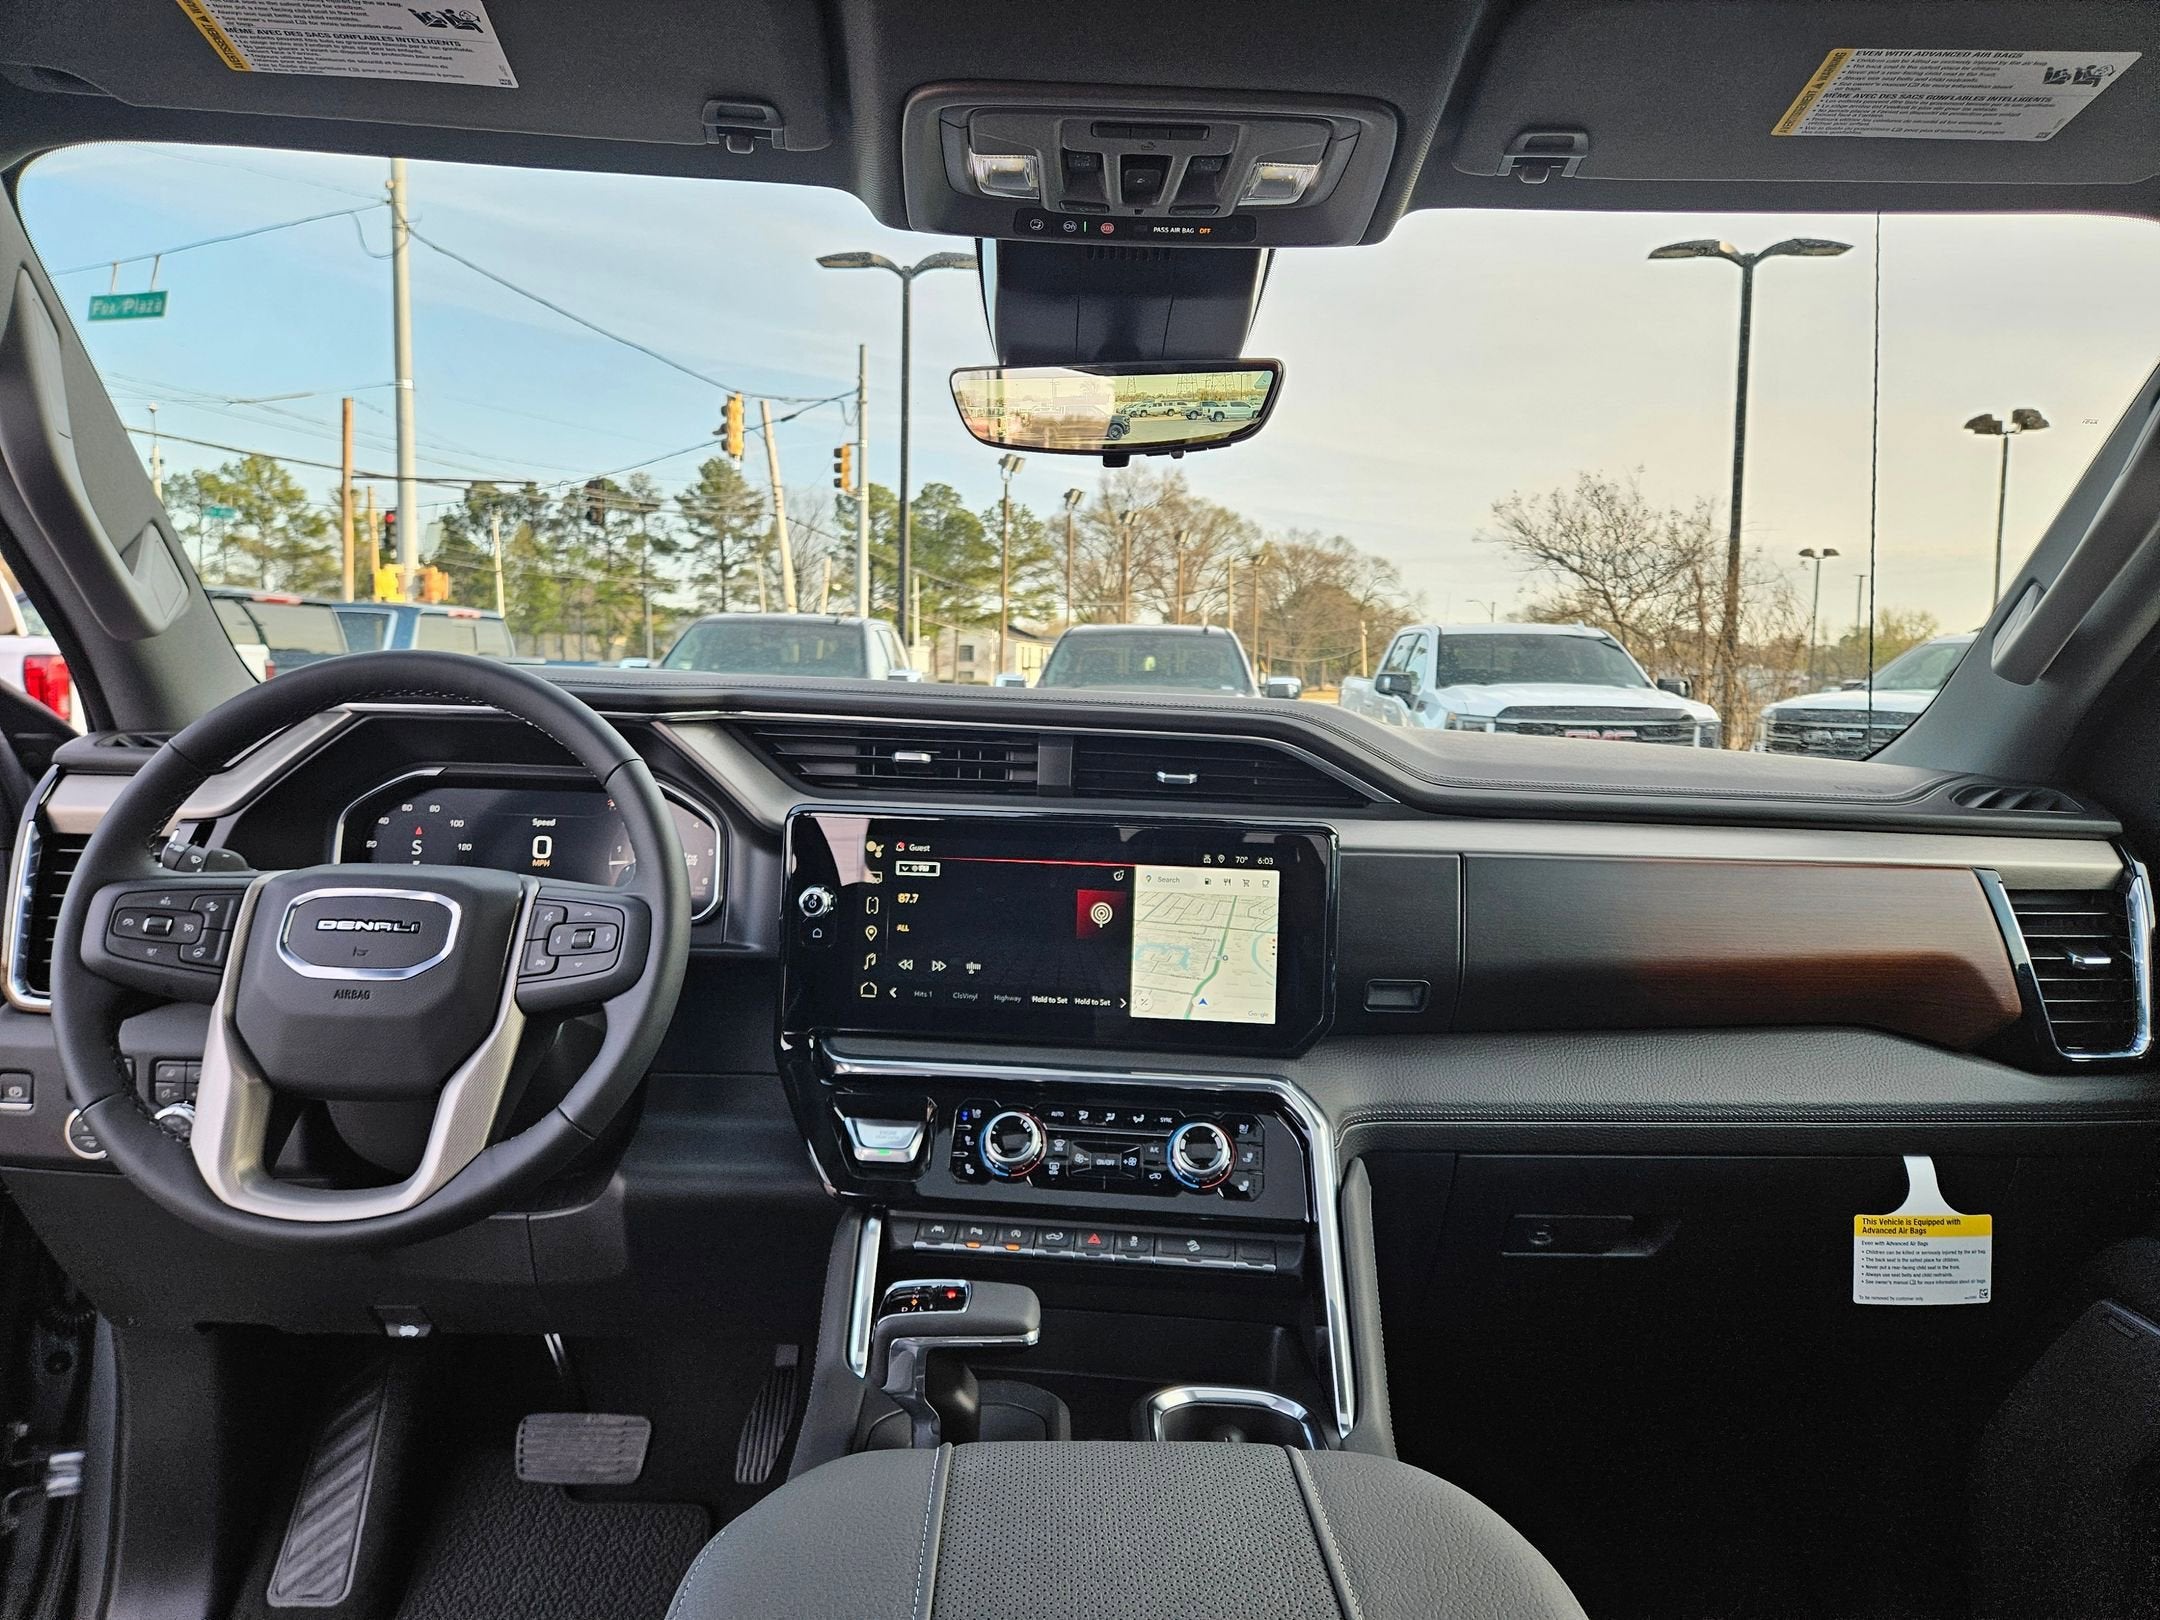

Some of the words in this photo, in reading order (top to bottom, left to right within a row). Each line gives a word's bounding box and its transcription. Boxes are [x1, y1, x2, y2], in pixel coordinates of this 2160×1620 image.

[532, 818, 556, 827] Speed
[412, 840, 422, 855] S
[532, 835, 552, 858] 0
[909, 844, 931, 852] Guest
[532, 859, 550, 867] MPH
[1236, 856, 1248, 864] 70°
[1258, 857, 1274, 865] 6:03
[897, 893, 919, 904] 87.7
[317, 920, 420, 933] DENALI
[334, 990, 370, 1000] AIRBAG
[953, 992, 978, 1001] ClsVinyl
[994, 994, 1021, 1003] Highway
[1914, 1218, 1944, 1227] Equipped
[1910, 1227, 1926, 1235] Bags
